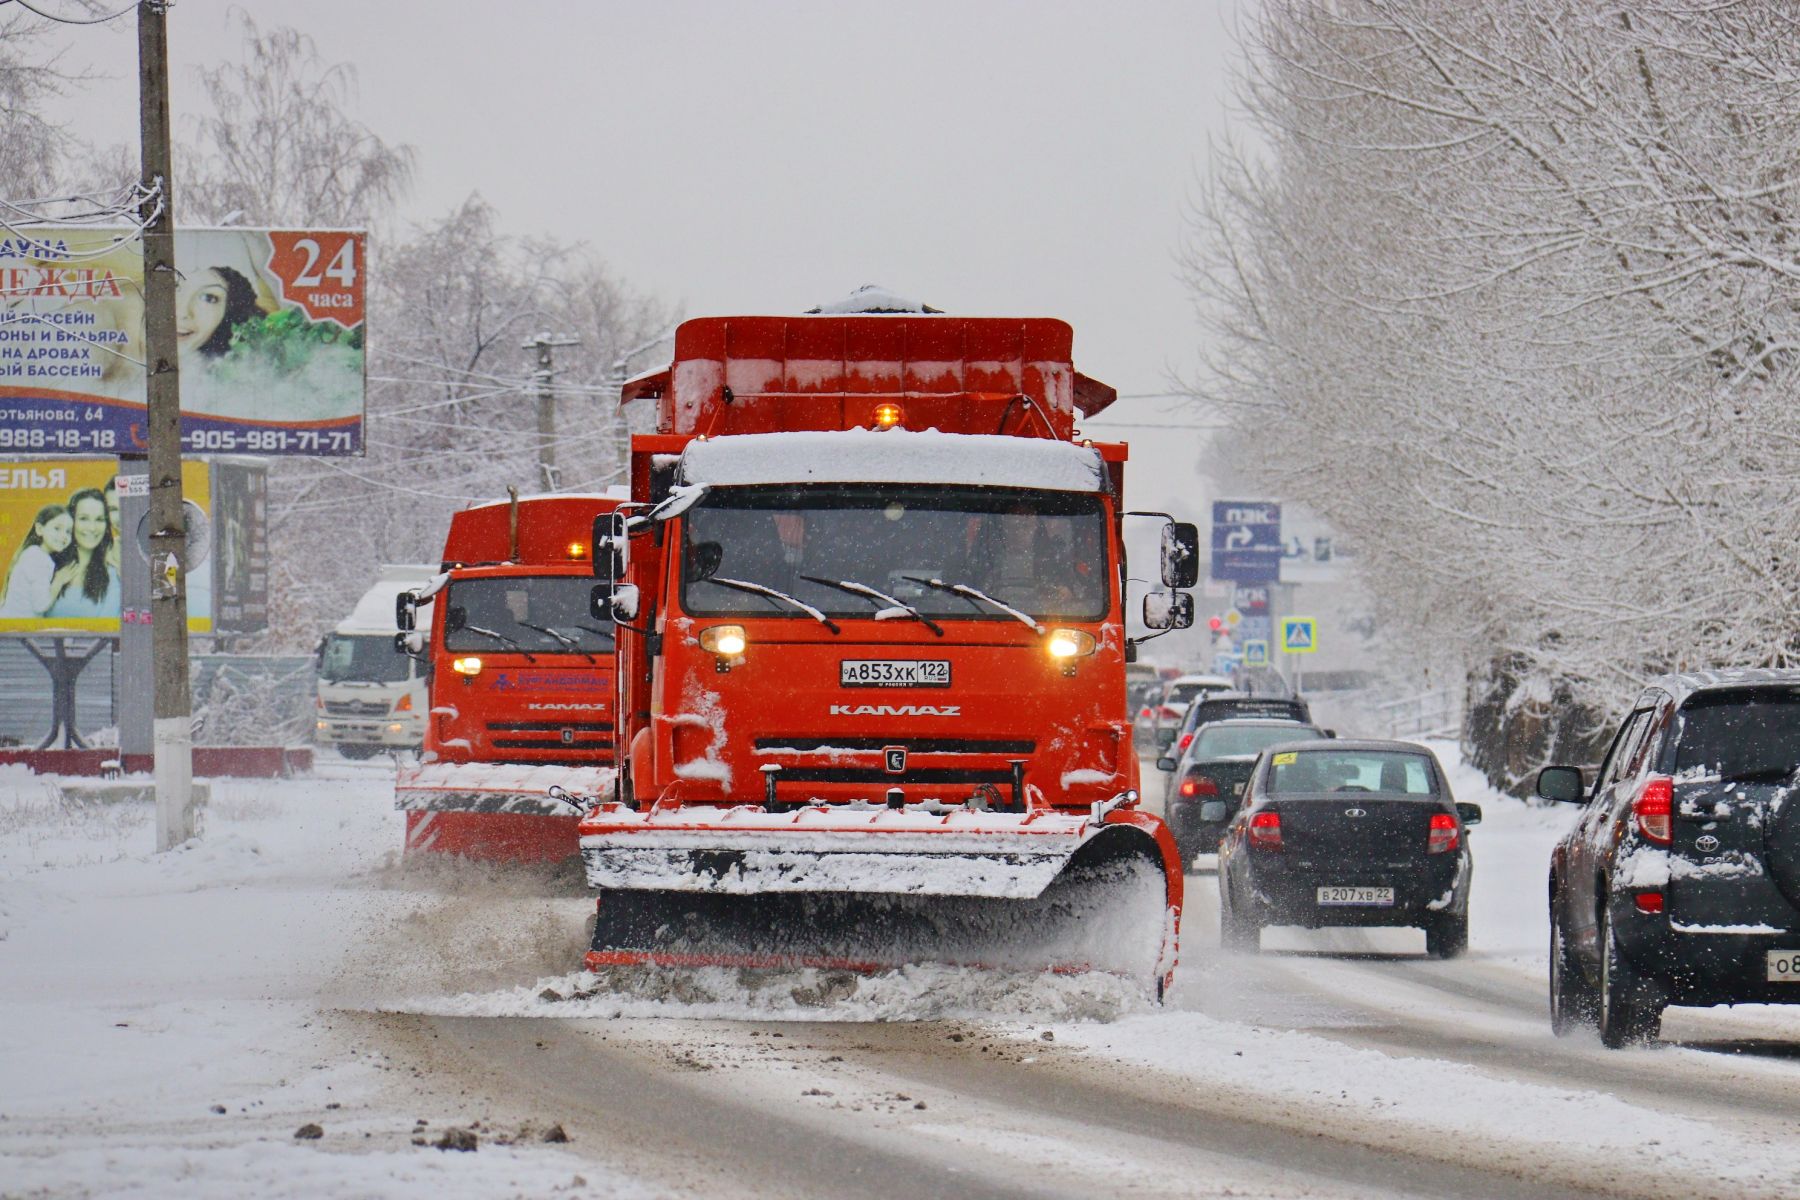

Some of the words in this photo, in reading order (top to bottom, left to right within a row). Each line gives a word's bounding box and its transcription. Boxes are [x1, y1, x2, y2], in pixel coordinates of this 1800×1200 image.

[292, 238, 357, 287] 24
[0, 268, 122, 301] ЕЖДА
[308, 293, 353, 307] часа
[41, 331, 51, 342] И
[2, 347, 23, 359] НА
[27, 347, 90, 359] ДРОВАХ
[27, 363, 101, 376] БАССЕЙН
[84, 406, 104, 421] 64
[919, 662, 945, 676] 122
[528, 703, 606, 711] KAMAZ
[829, 705, 961, 716] KAMAZ
